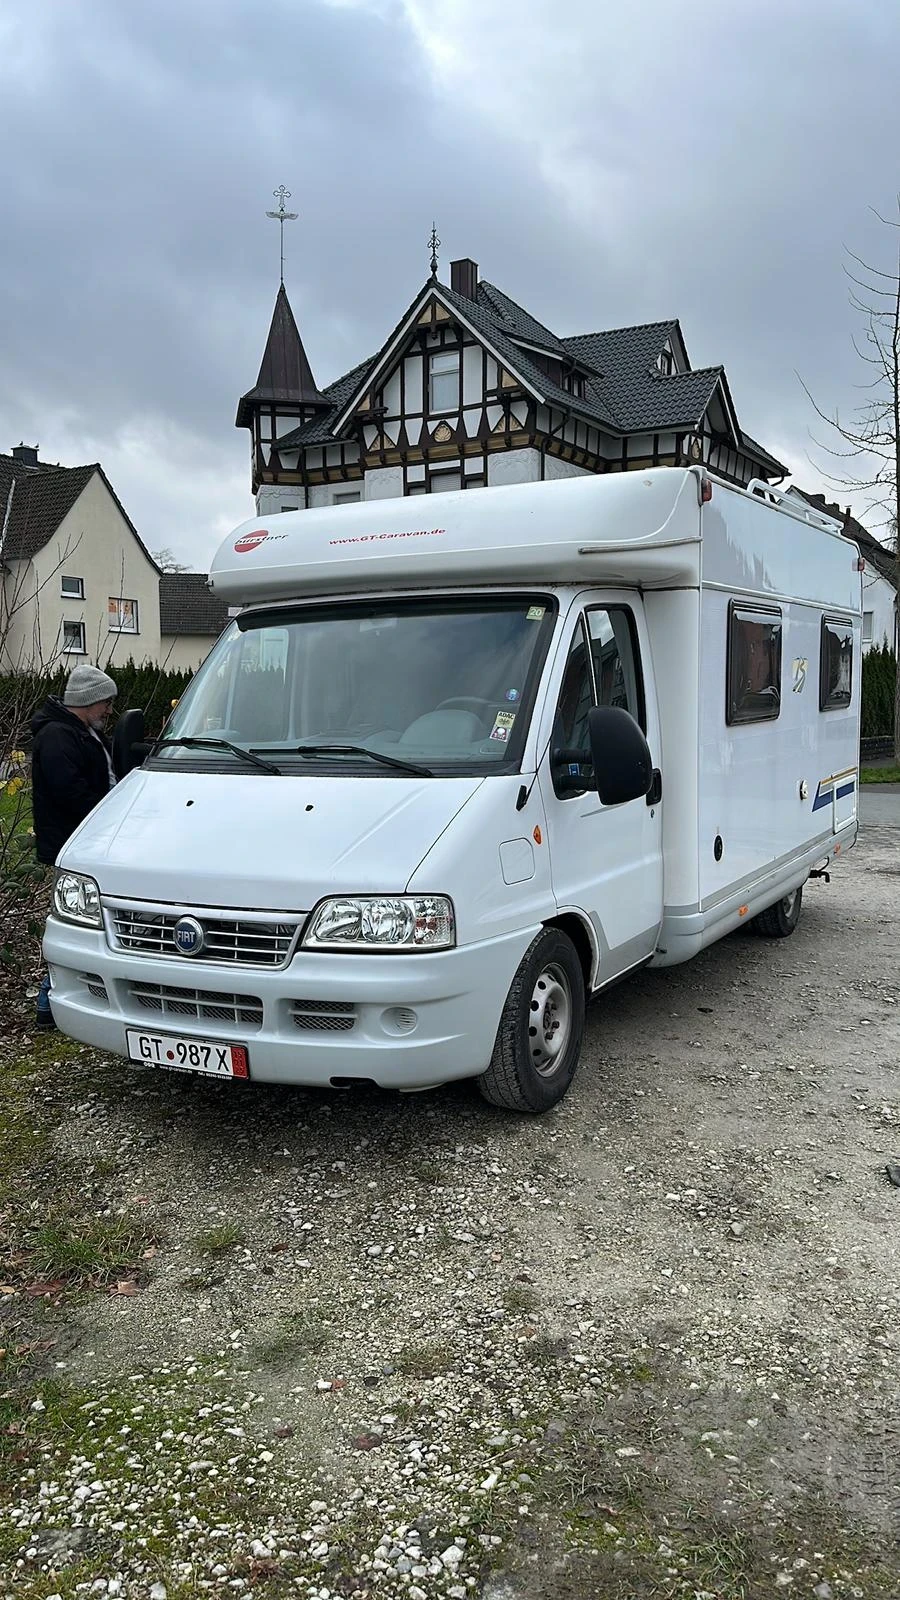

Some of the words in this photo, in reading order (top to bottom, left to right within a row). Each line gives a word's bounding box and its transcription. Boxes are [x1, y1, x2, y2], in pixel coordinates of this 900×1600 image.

[328, 528, 446, 545] www.GT-Caravan.de
[530, 608, 542, 617] 20
[177, 931, 195, 942] FIAT
[139, 1036, 162, 1060] GT
[176, 1042, 211, 1068] 987
[215, 1048, 230, 1072] X
